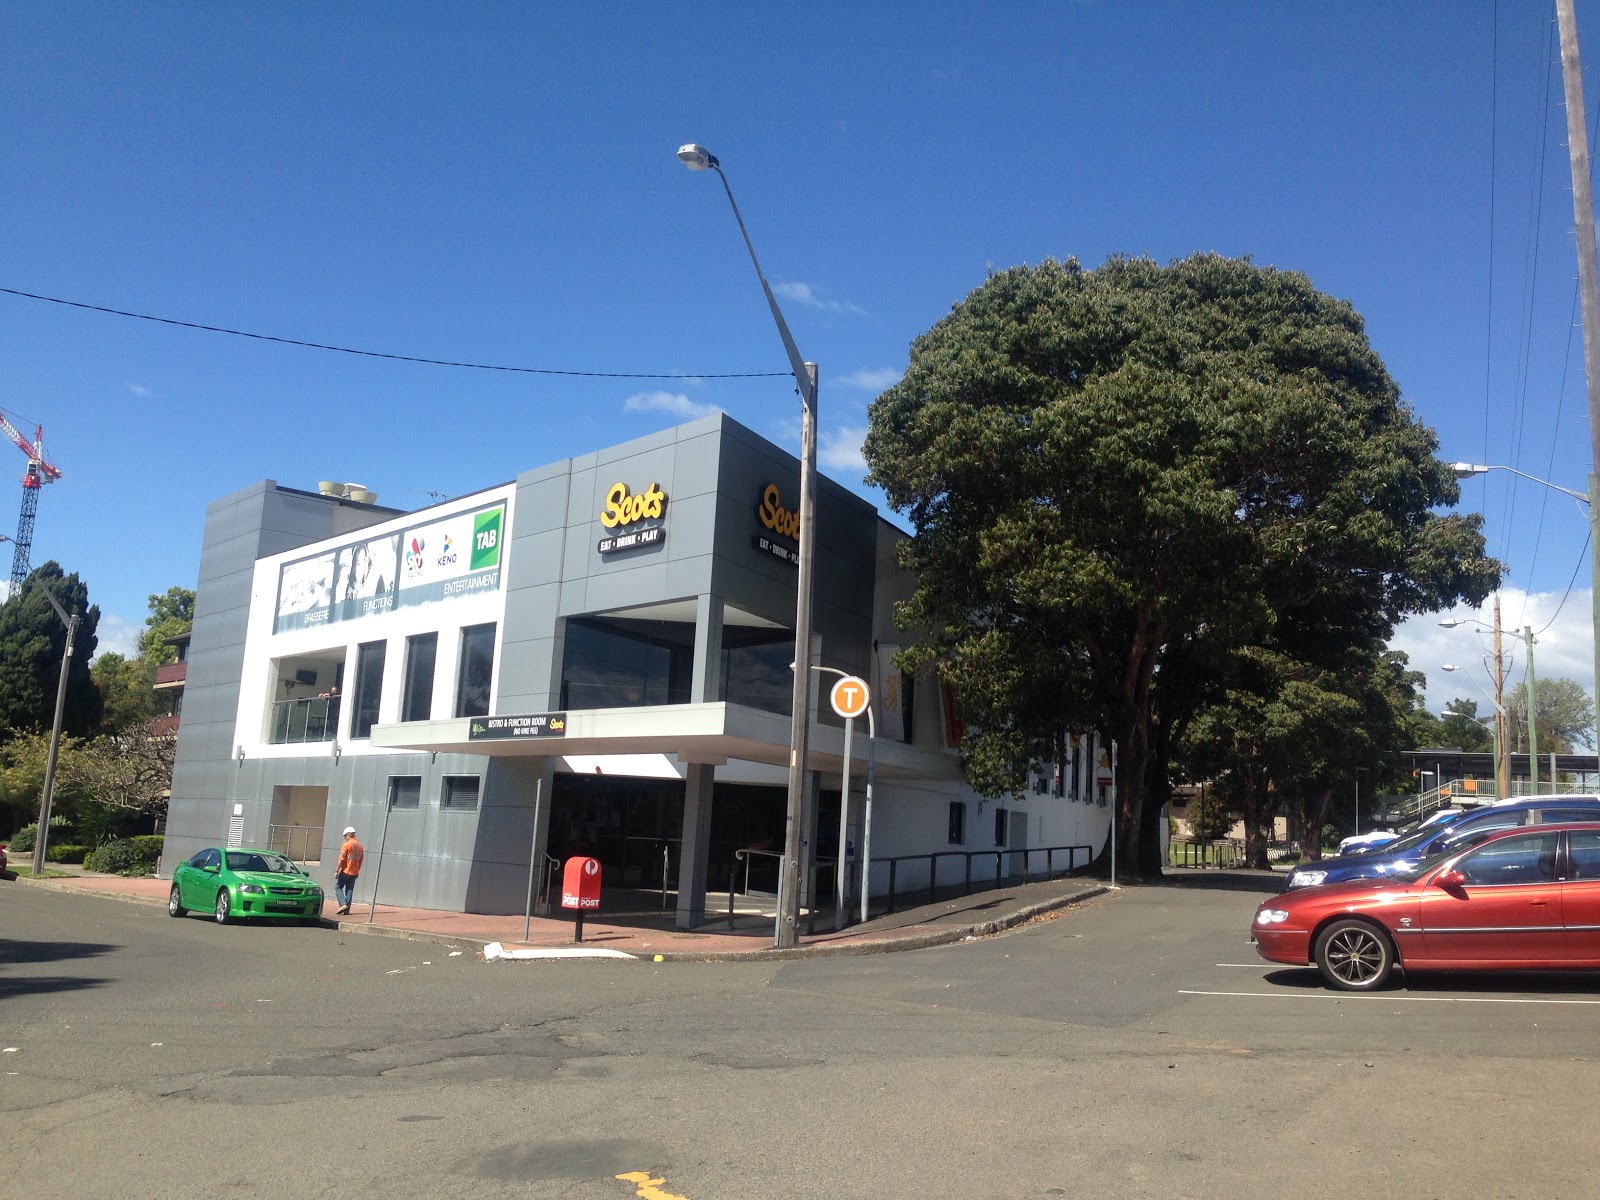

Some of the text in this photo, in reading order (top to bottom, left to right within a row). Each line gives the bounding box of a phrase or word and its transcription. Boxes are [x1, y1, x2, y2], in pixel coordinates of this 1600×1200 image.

[600, 482, 665, 528] Scots
[759, 483, 800, 541] Scot
[476, 529, 496, 551] TAB
[600, 529, 658, 551] EAT DRINK PLAY
[760, 538, 769, 550] EAT
[772, 544, 788, 559] DRINK
[437, 554, 457, 567] KENO
[444, 573, 498, 594] ENTERTAINMENT
[363, 595, 393, 611] FUNCTIONS
[304, 609, 330, 623] BRASSERIE
[843, 687, 858, 709] T
[488, 719, 504, 728] BISTRO
[508, 718, 531, 727] FUNCTION
[531, 717, 546, 726] ROOM
[564, 896, 579, 906] POST
